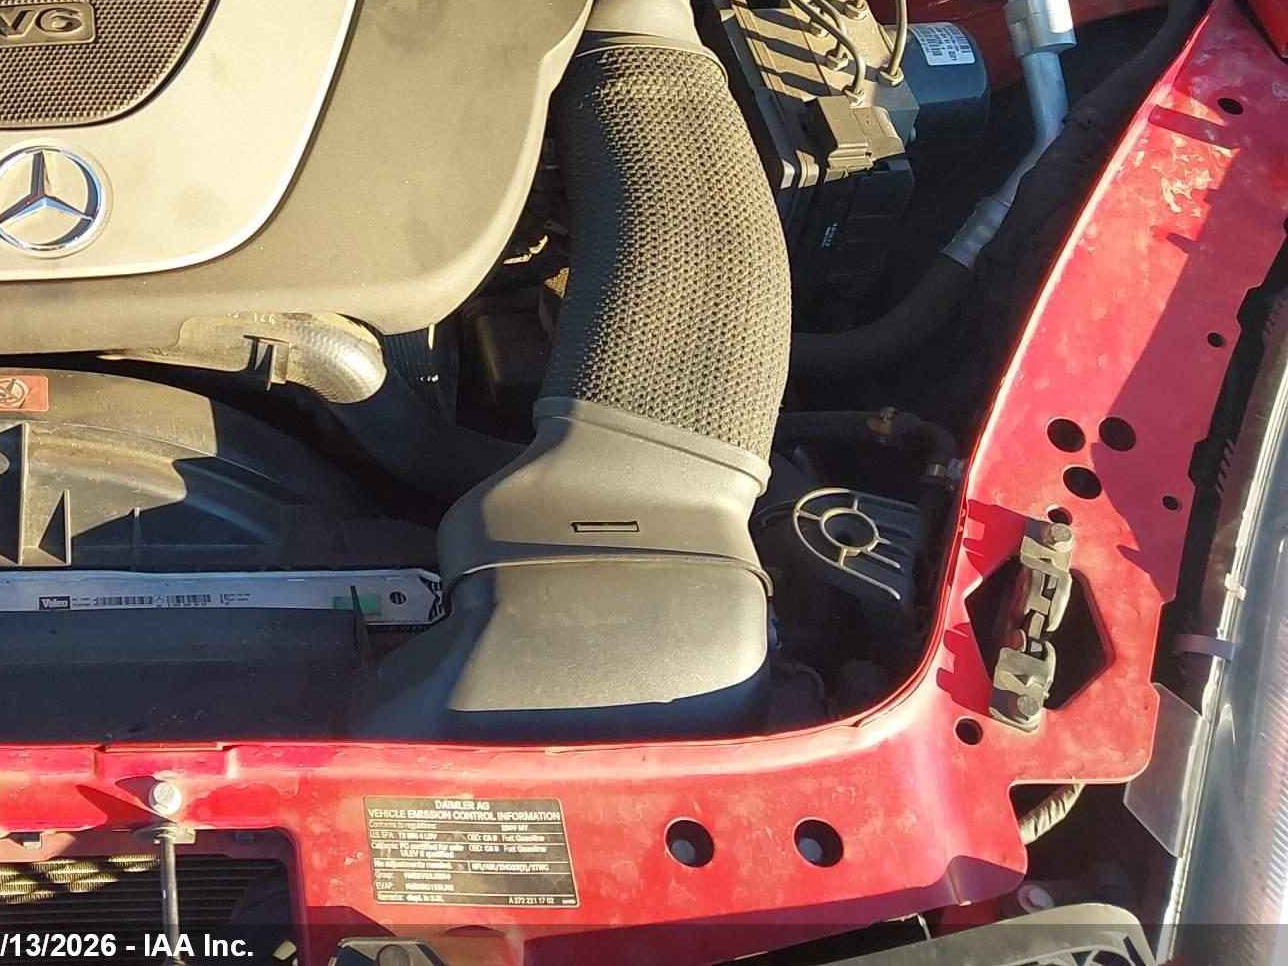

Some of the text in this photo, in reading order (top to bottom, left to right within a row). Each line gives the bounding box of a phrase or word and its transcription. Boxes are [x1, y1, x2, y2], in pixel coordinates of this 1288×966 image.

[434, 800, 490, 811] DAIMLER AG
[368, 809, 561, 821] VEHICLE EMISSION CONTROL INFORMATION
